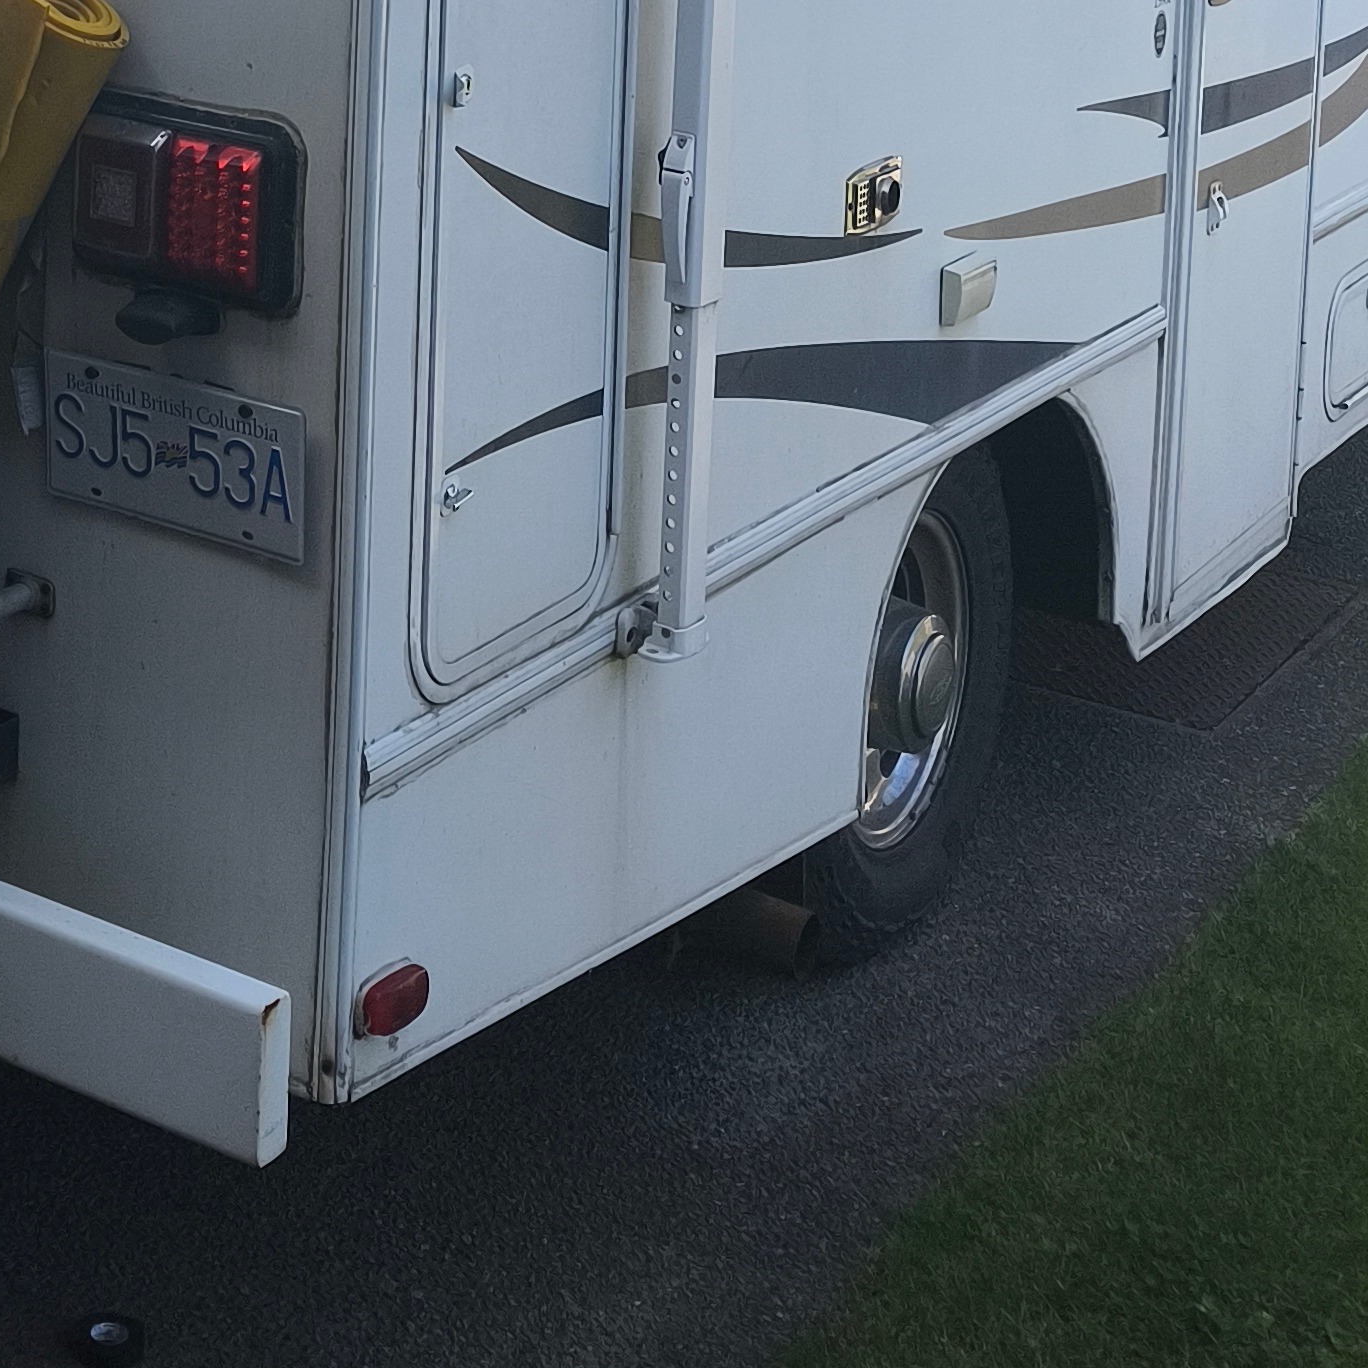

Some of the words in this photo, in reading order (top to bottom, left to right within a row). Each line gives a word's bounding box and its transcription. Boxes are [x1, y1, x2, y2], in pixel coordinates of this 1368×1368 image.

[53, 392, 154, 478] SJ5
[187, 424, 293, 524] 53A
[66, 372, 137, 407] Beautiful
[140, 390, 193, 421] British
[196, 405, 280, 444] Columbia
